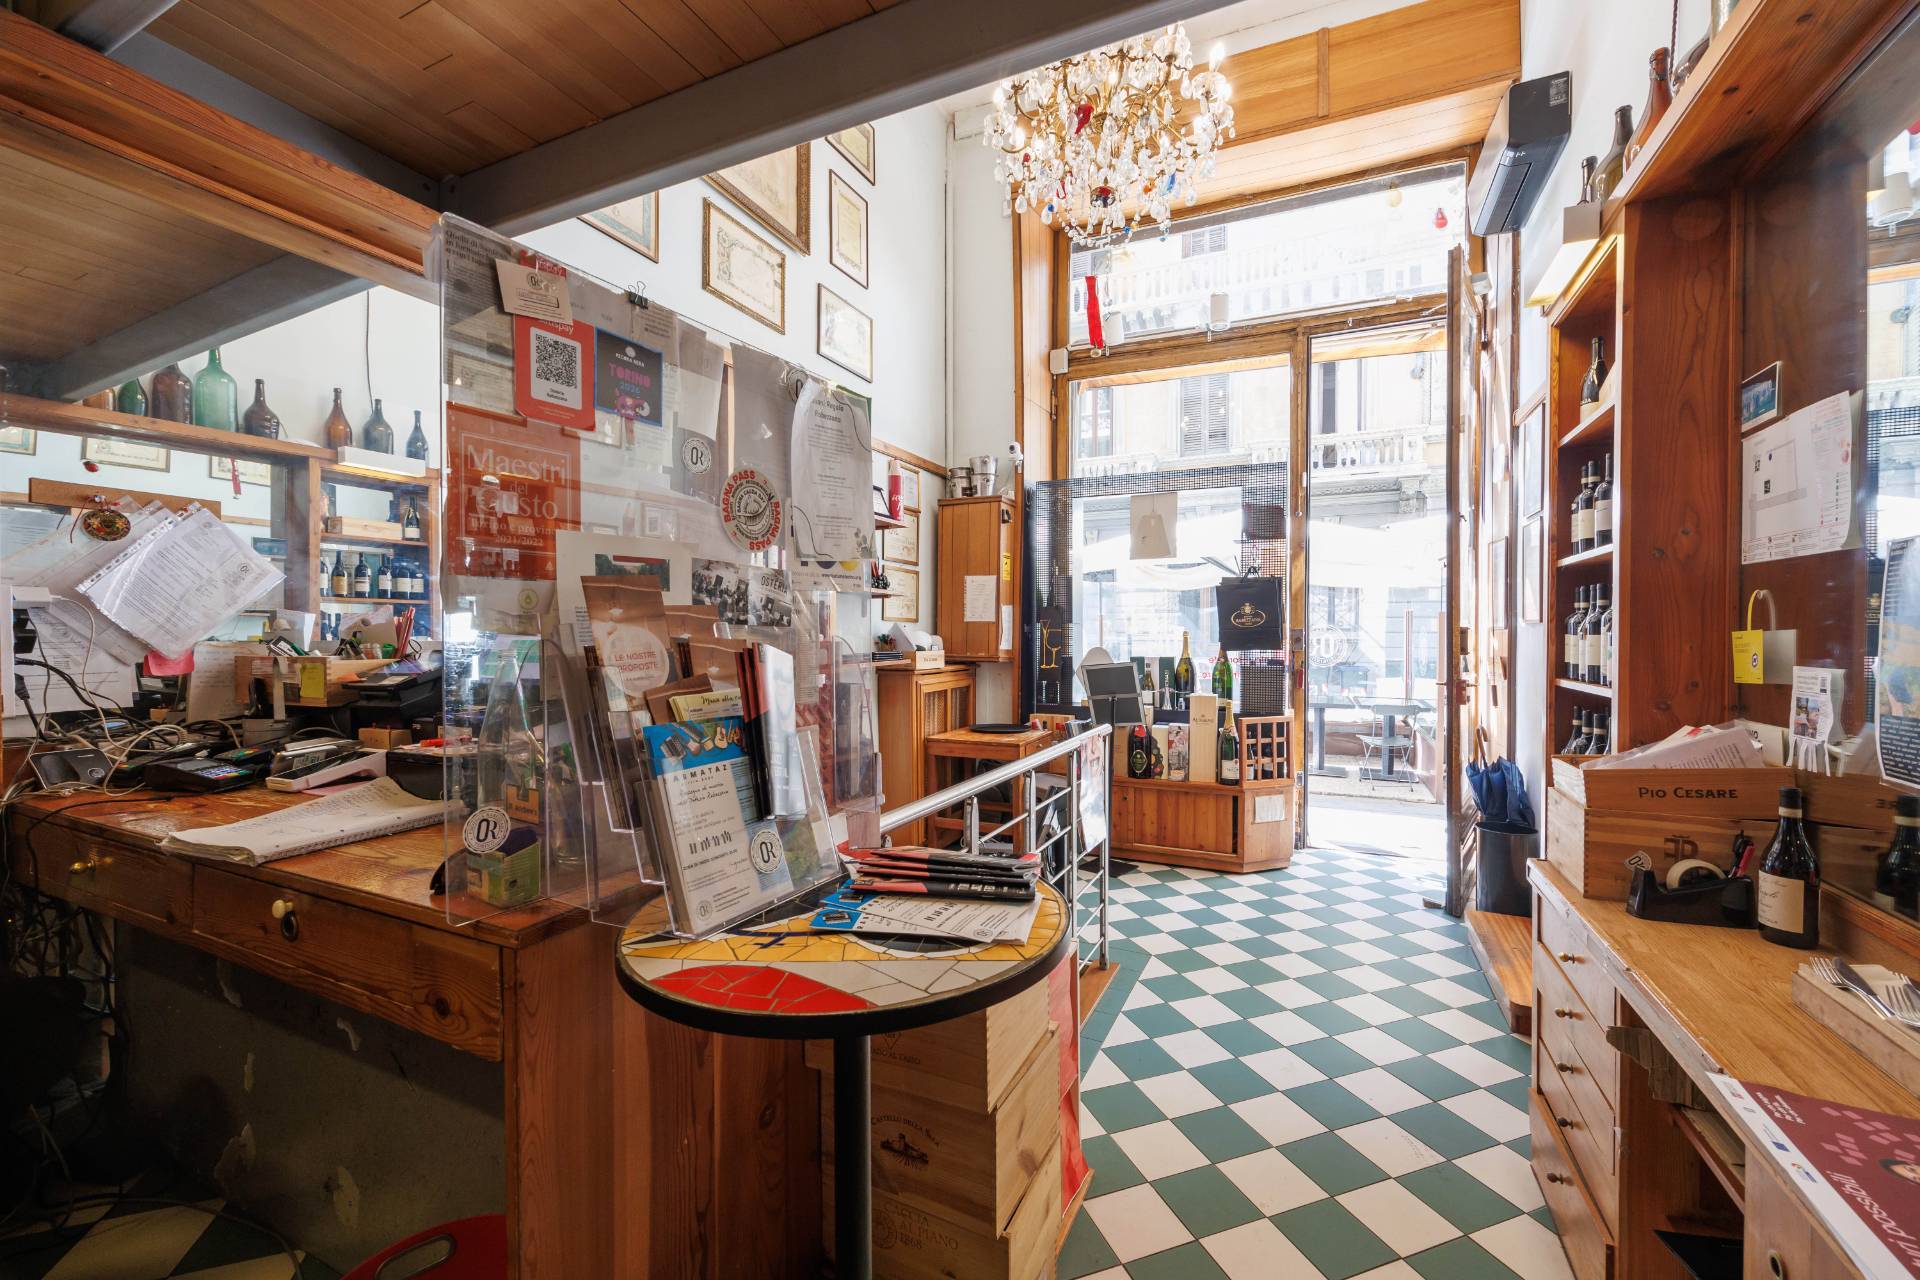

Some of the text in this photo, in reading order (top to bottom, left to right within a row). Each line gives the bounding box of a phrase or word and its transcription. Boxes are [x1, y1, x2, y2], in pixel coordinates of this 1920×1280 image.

[608, 362, 651, 388] TORINO
[467, 444, 567, 485] Maestri
[510, 480, 529, 496] del
[732, 470, 756, 485] PASS
[475, 487, 559, 520] Gusto
[722, 482, 735, 523] BAGNA
[771, 500, 781, 538] BAGNA
[749, 536, 772, 551] PASS
[760, 575, 789, 594] OSTERIA
[614, 651, 657, 662] LE NOSTRE
[475, 818, 498, 843] OR
[759, 841, 777, 864] OR
[917, 1224, 959, 1250] PIANO
